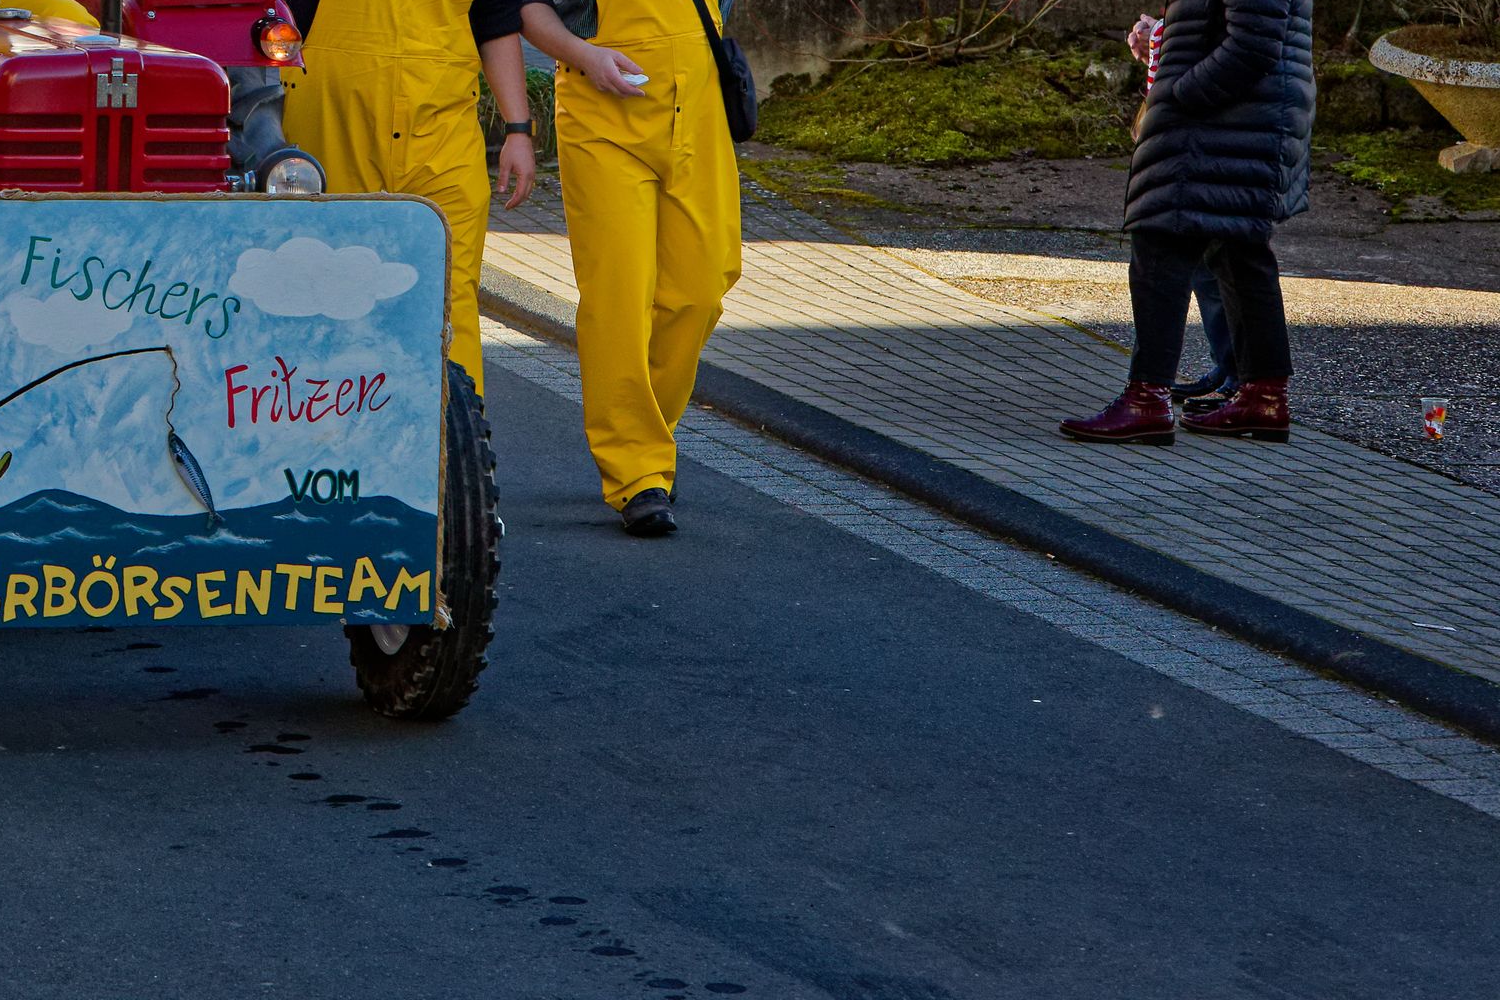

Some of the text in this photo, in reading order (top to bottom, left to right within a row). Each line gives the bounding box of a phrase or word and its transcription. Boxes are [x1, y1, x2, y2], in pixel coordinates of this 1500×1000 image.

[21, 236, 240, 338] Fischers
[225, 356, 391, 428] Fritzen
[284, 468, 360, 504] VOM
